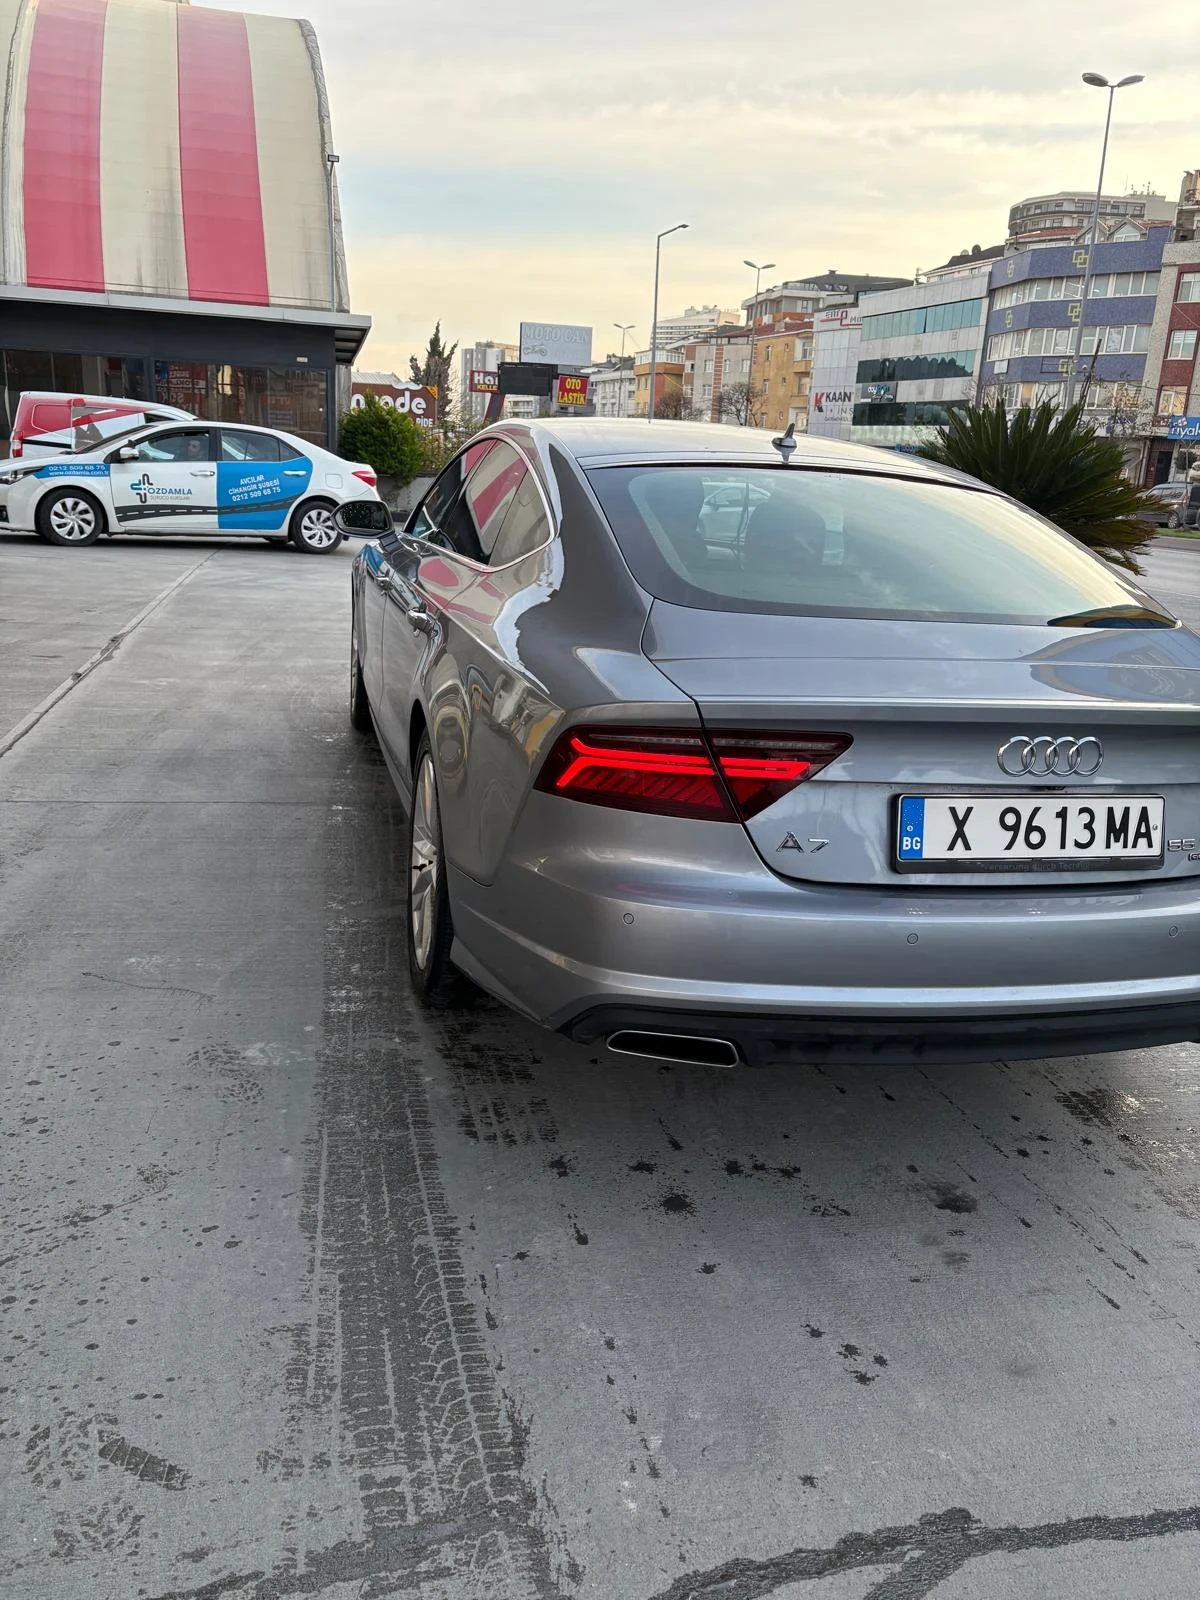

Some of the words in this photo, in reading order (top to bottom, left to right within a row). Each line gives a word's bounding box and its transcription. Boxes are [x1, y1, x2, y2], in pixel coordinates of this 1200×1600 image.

[524, 325, 561, 342] MOTO
[565, 378, 582, 390] OTO
[558, 391, 585, 405] LASTİK
[825, 392, 852, 403] KAAN
[240, 474, 265, 486] AVCILAR
[232, 492, 249, 502] 0212
[250, 490, 262, 499] 509
[947, 806, 974, 851] X
[902, 836, 921, 850] BG
